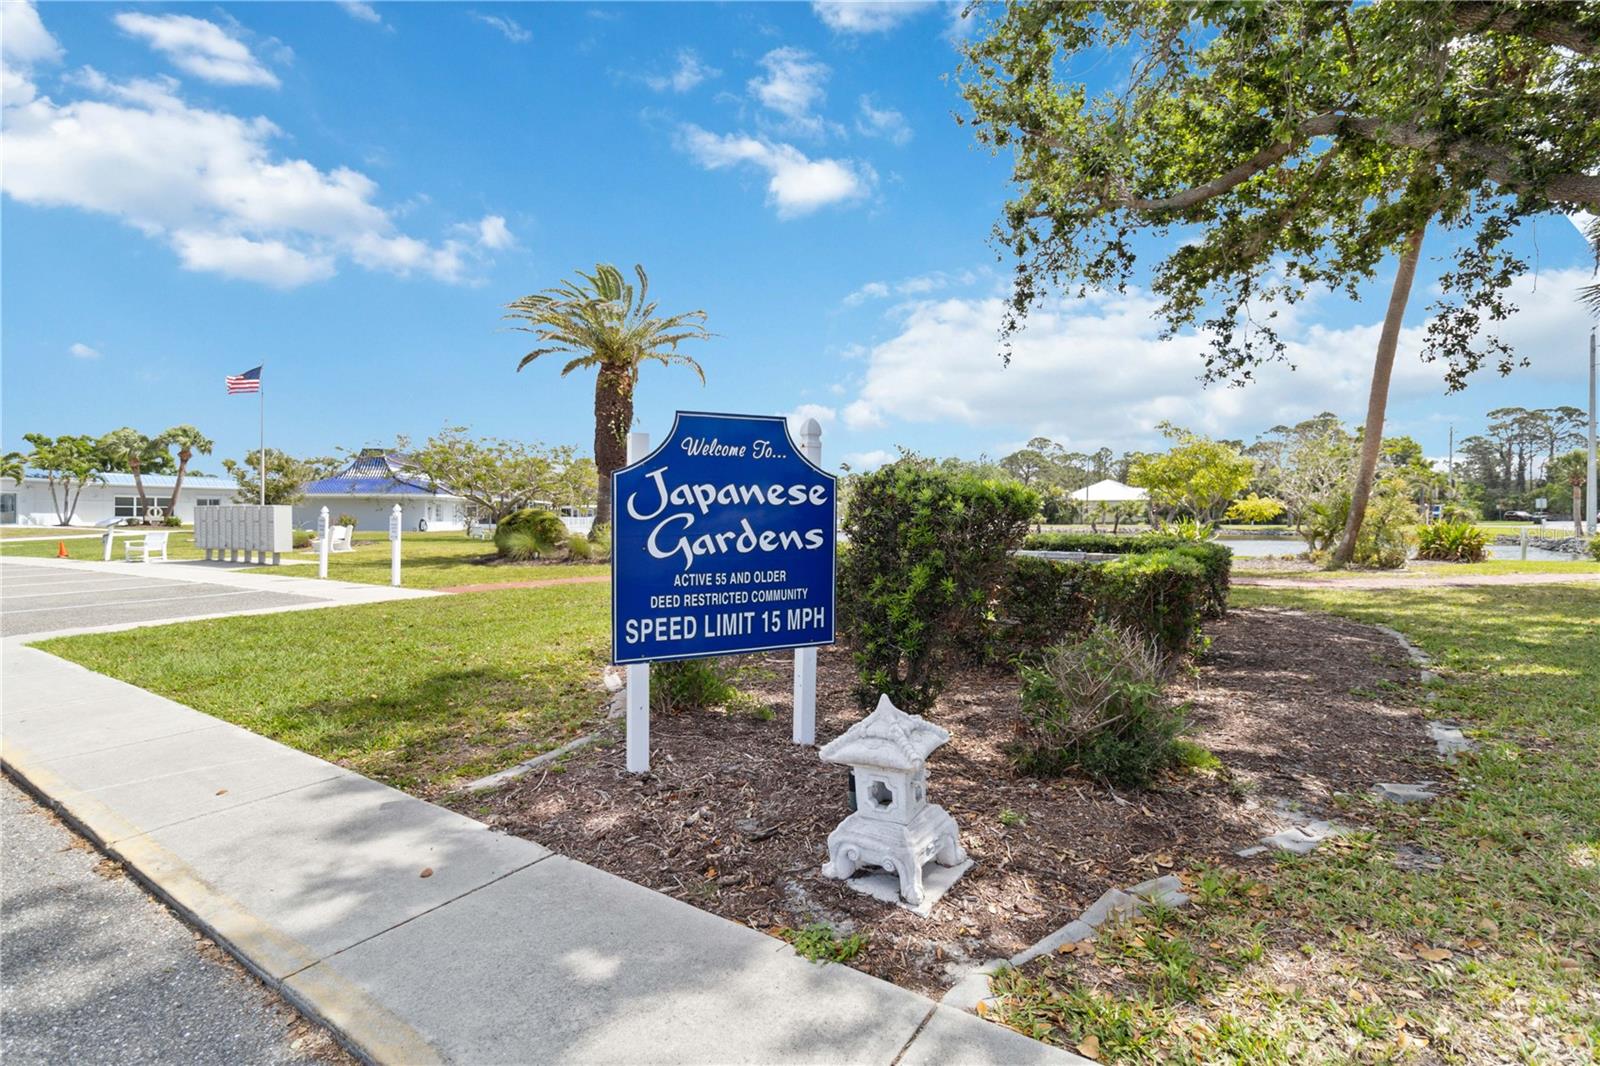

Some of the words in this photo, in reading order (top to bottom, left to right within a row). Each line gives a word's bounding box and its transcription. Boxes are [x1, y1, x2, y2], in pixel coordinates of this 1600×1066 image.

[681, 436, 746, 457] Welcome
[627, 466, 828, 520] Japanese
[647, 512, 824, 571] Gardens
[673, 573, 713, 587] ACTIVE
[715, 573, 727, 585] 55
[729, 571, 751, 584] AND
[753, 570, 787, 583] OLDER
[650, 595, 680, 609] DEED
[684, 591, 749, 607] RESTRICTED
[751, 588, 808, 603] COMMUNITY
[625, 616, 697, 644] SPEED
[704, 612, 756, 638] LIMIT
[761, 610, 781, 633] 15
[787, 607, 825, 631] MPH
